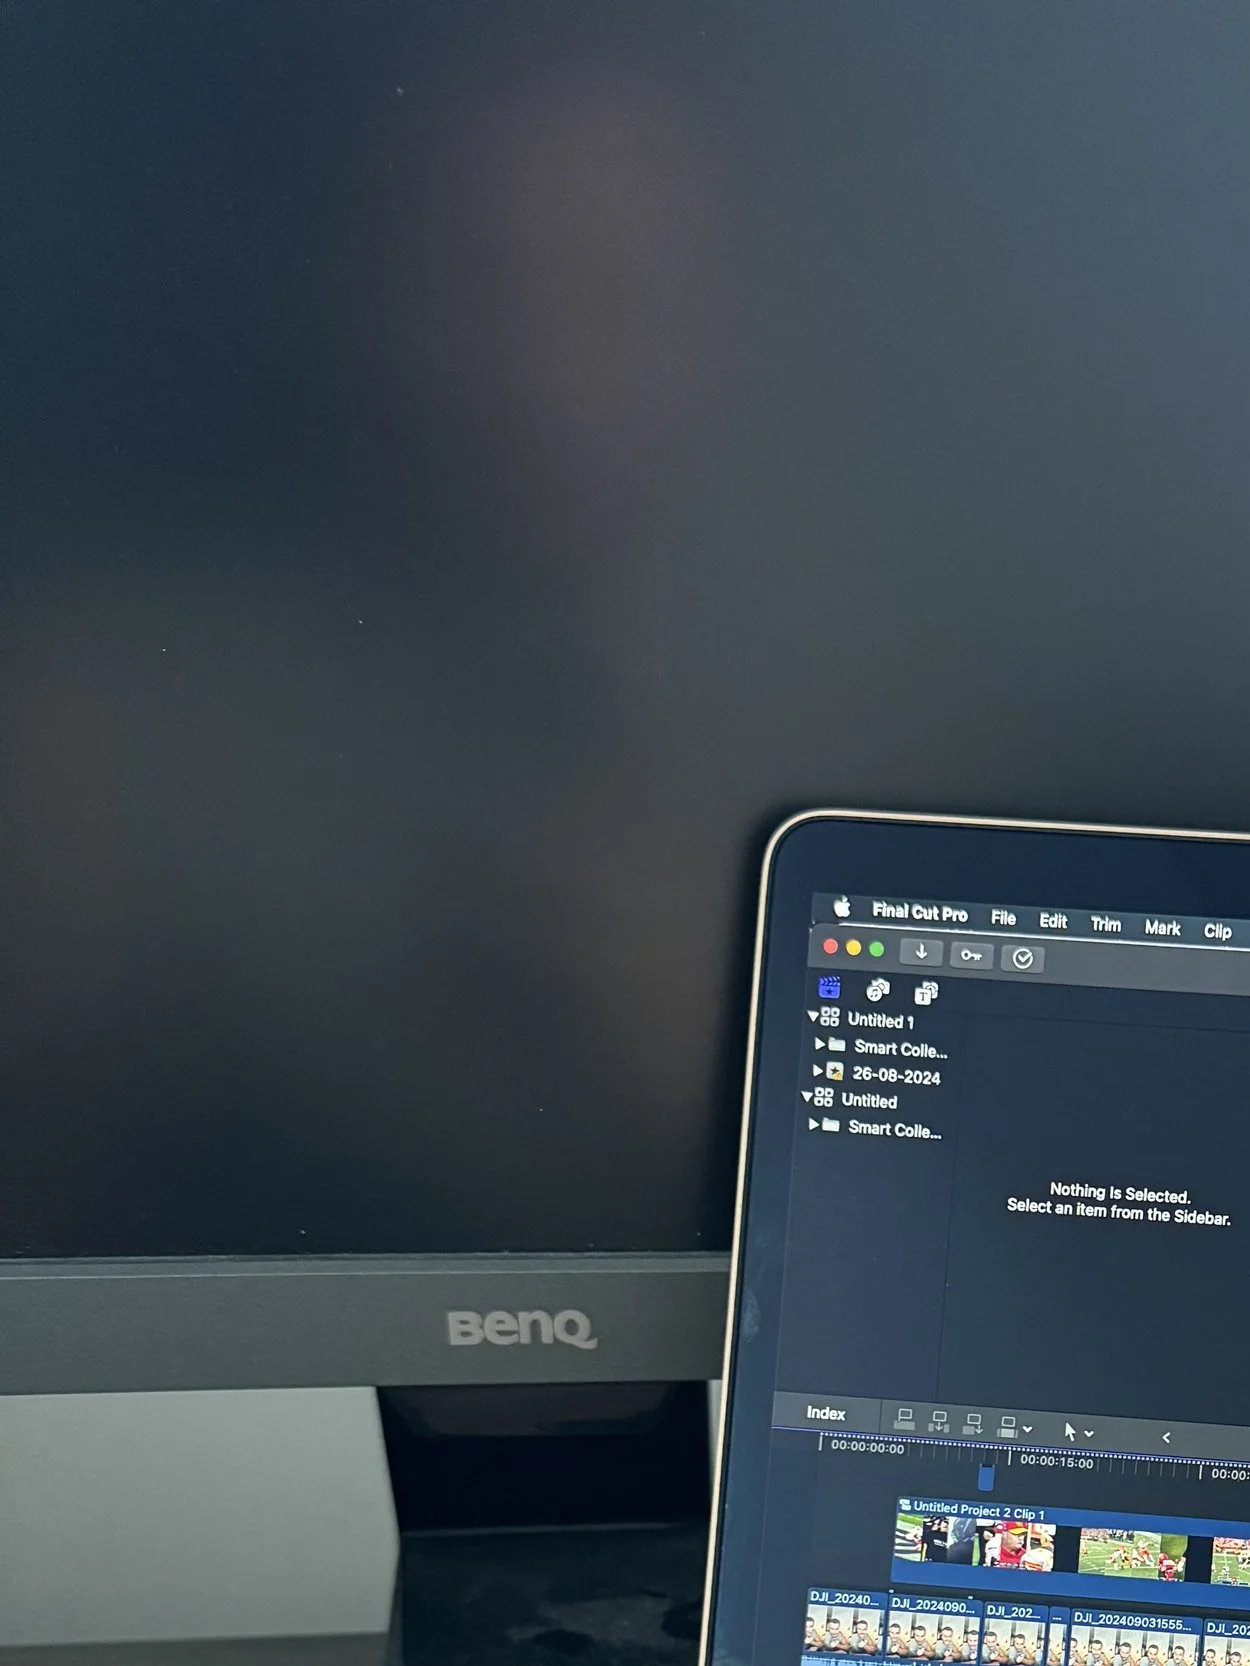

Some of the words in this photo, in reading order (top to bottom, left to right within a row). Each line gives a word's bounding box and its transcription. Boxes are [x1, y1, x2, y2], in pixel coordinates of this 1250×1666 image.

[872, 902, 908, 920] Final
[912, 905, 939, 921] Cut
[942, 907, 968, 923] Pro
[991, 910, 1017, 926] File
[1040, 913, 1068, 929] Edit
[1091, 916, 1122, 932] Trim
[1145, 920, 1181, 936] Mark
[1204, 923, 1233, 942] Clip
[848, 1011, 903, 1029] Untitled
[907, 1016, 914, 1029] 1
[854, 1039, 897, 1057] Smart
[853, 1066, 941, 1086] 26-08-2024
[841, 1092, 898, 1110] Untitled
[848, 1119, 891, 1137] Smart
[1050, 1182, 1106, 1202] Nothing
[1109, 1186, 1122, 1201] Is
[1125, 1187, 1192, 1205] Selected.
[1007, 1198, 1052, 1215] Select
[1055, 1203, 1073, 1216] an
[1076, 1202, 1107, 1219] item
[1110, 1203, 1144, 1221] from
[1147, 1206, 1170, 1223] the
[1173, 1207, 1232, 1226] Sidebar.
[447, 1309, 598, 1350] BenQ
[807, 1405, 847, 1421] Index
[831, 1438, 905, 1455] 00:00:00:00
[1020, 1453, 1094, 1470] 00:00:15:00
[913, 1500, 958, 1514] Untitled
[961, 1504, 1001, 1519] Project
[1003, 1507, 1011, 1518] 2
[1014, 1508, 1036, 1521] Clip
[1039, 1510, 1045, 1520] 1
